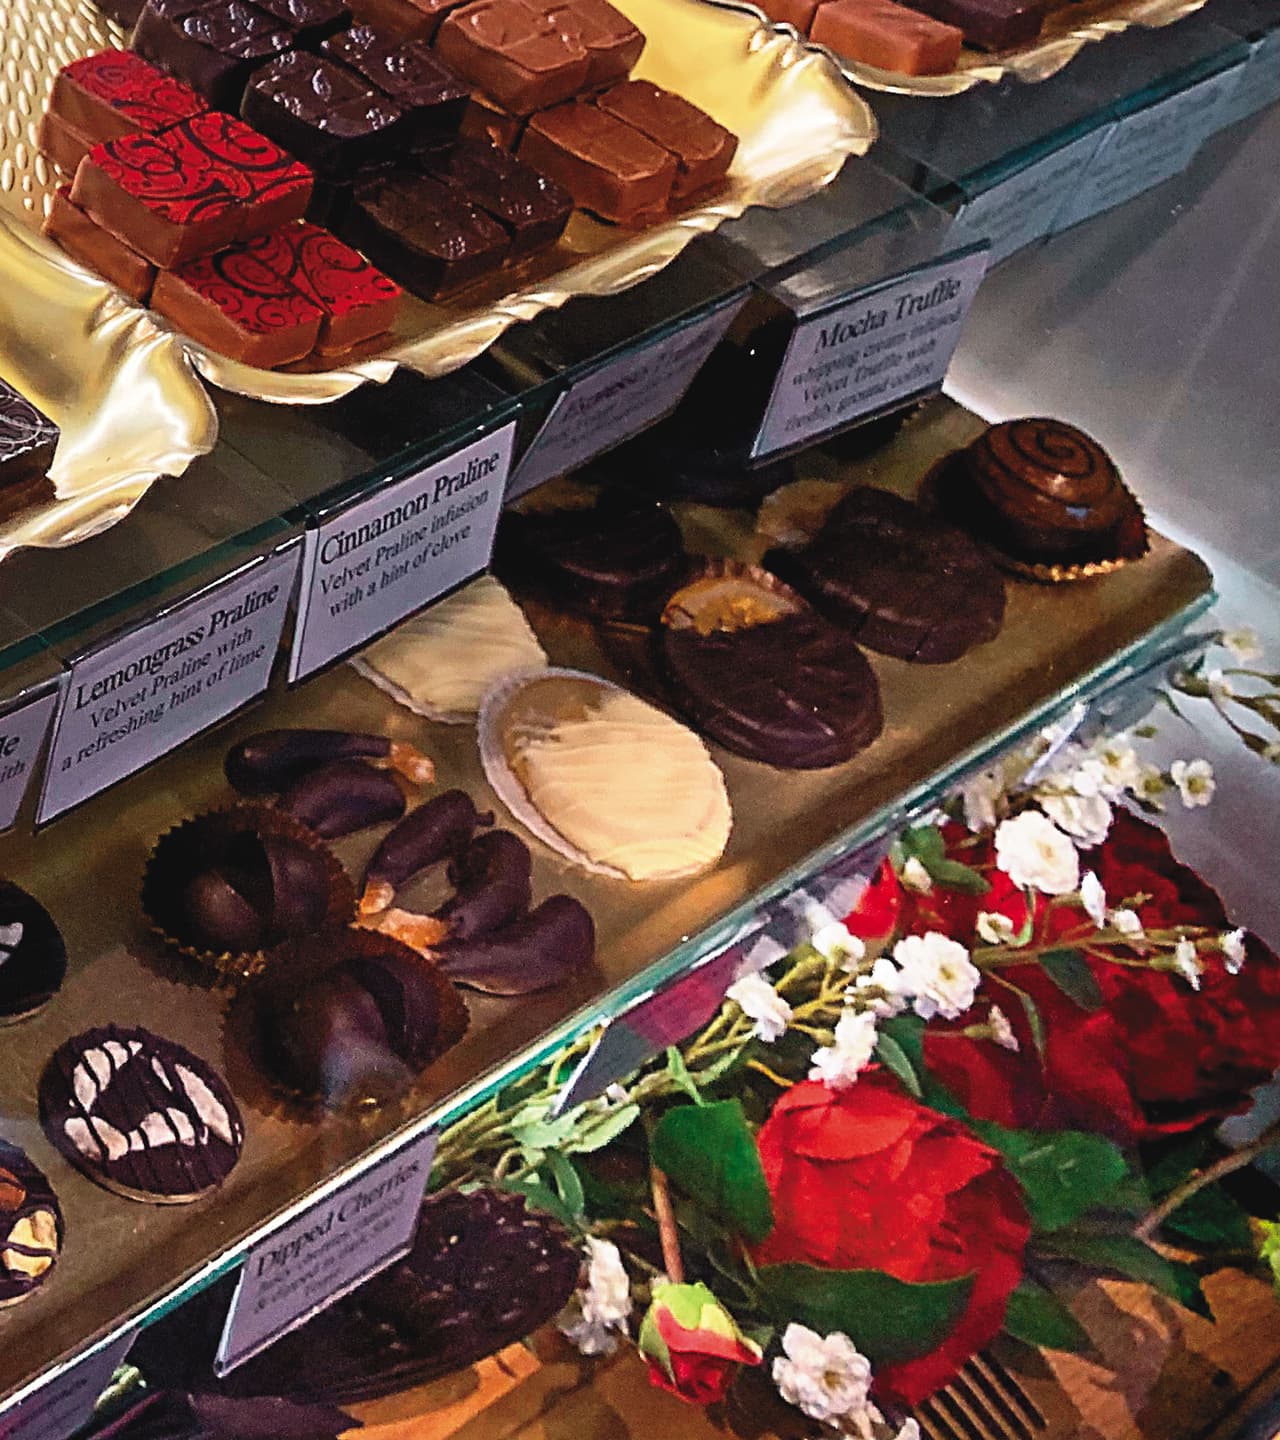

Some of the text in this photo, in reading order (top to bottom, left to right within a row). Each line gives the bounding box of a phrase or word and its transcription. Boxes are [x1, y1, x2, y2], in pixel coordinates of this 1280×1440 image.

[814, 310, 888, 354] Mocha
[320, 452, 500, 564] Cinnamon Praline
[320, 489, 489, 595] Velvet Praline infusion
[329, 524, 472, 617] with a hint of clove
[74, 583, 279, 710] Lemongrass Praline
[90, 627, 253, 728] Velvet Praline with
[61, 644, 266, 771] a refreshing hint of lime
